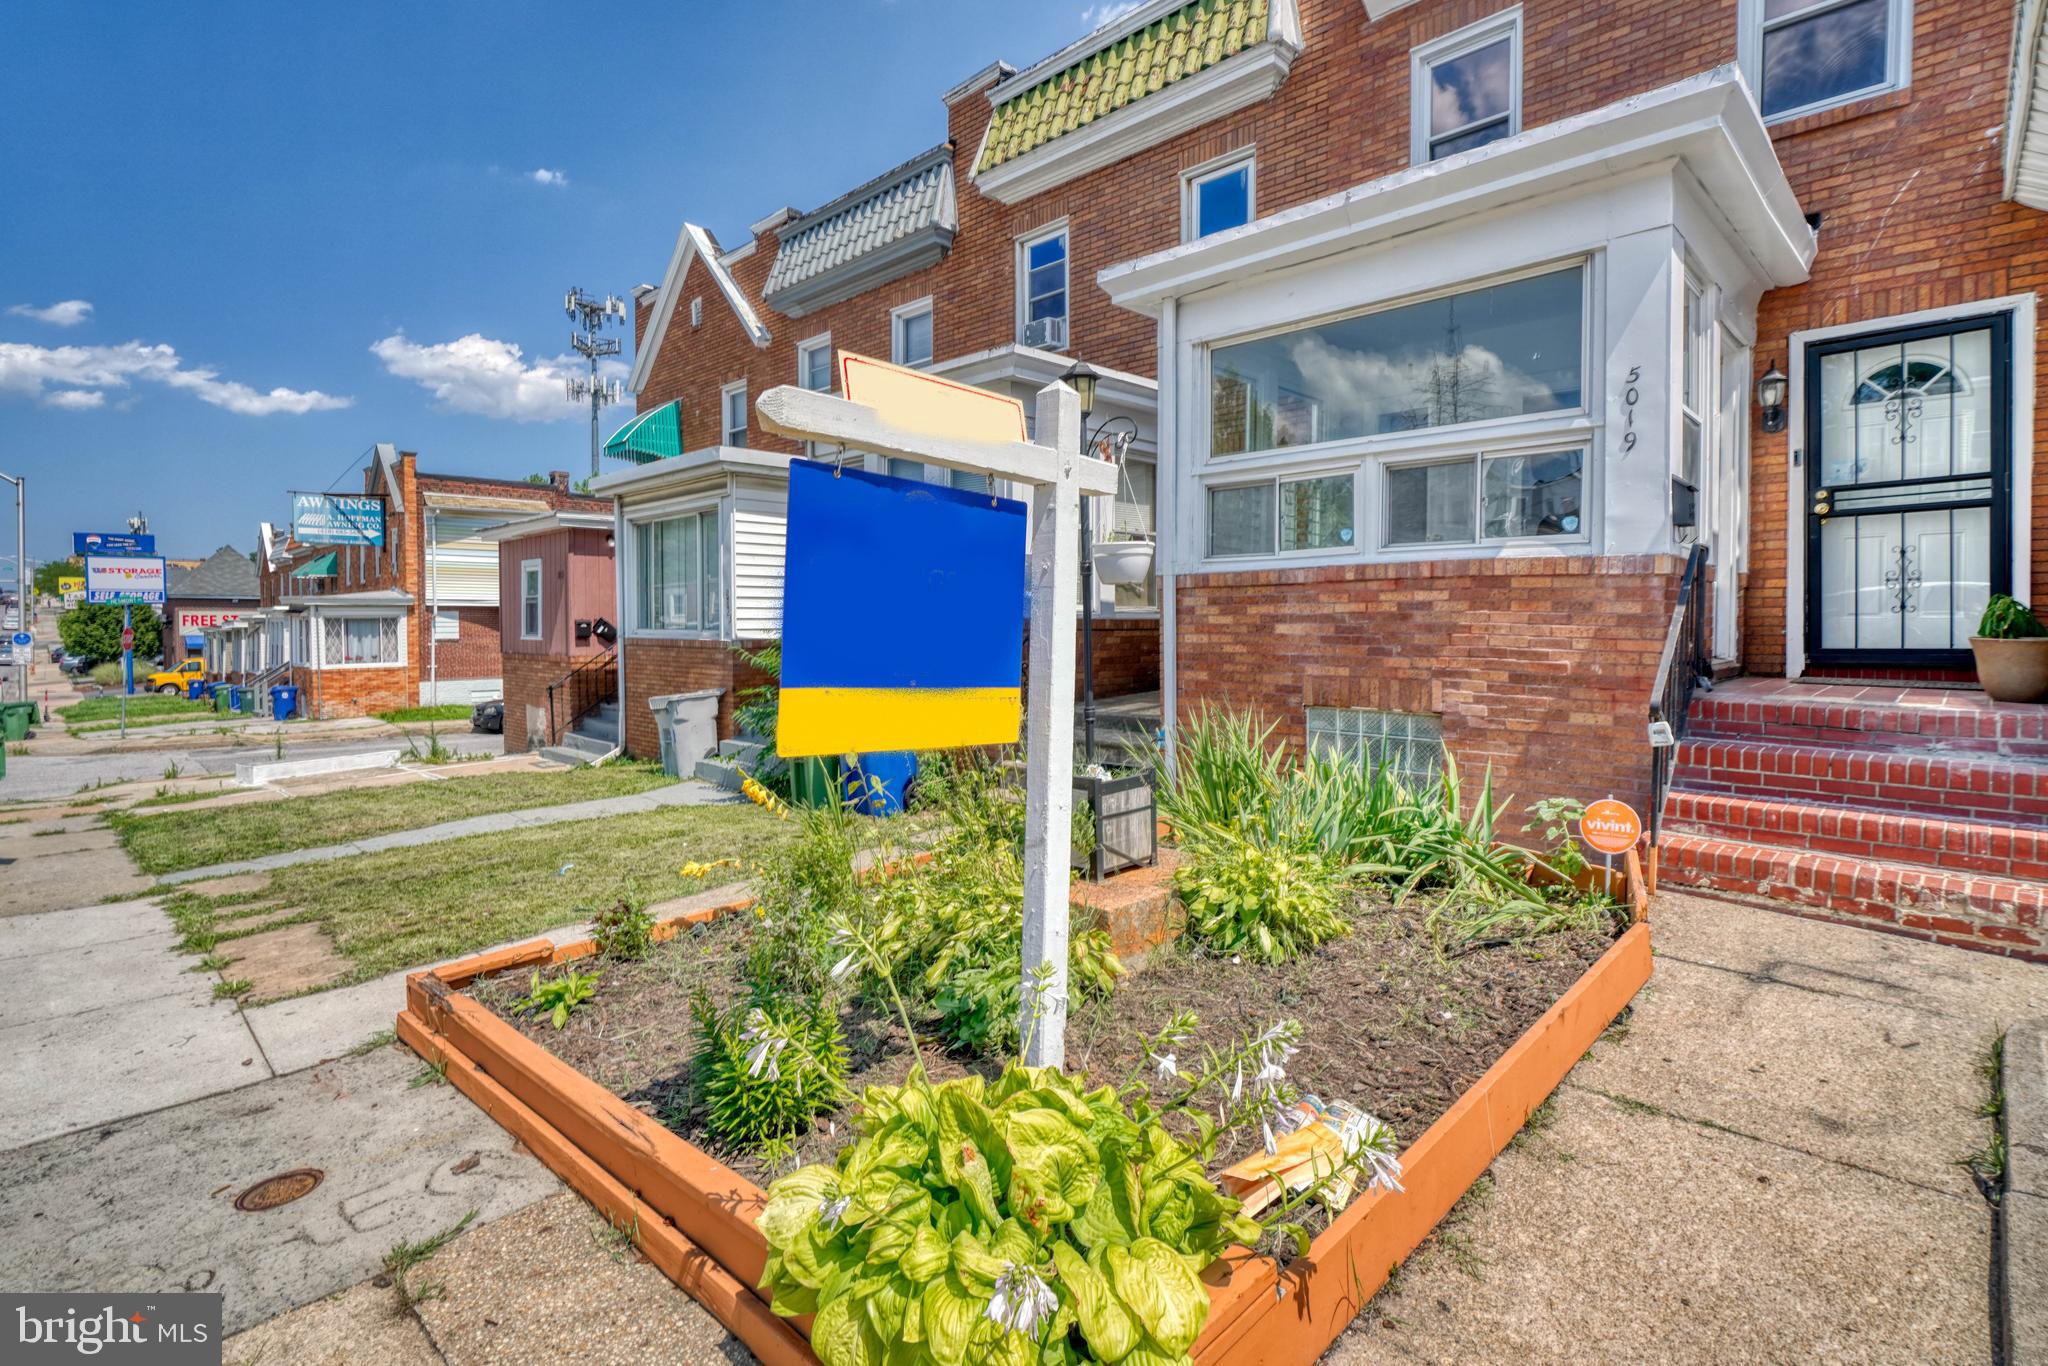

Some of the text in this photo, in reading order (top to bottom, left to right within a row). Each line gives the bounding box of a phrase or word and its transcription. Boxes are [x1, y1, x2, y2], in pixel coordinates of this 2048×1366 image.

[1624, 365, 1642, 453] 5019
[94, 591, 115, 600] SELF
[182, 614, 218, 627] FREE
